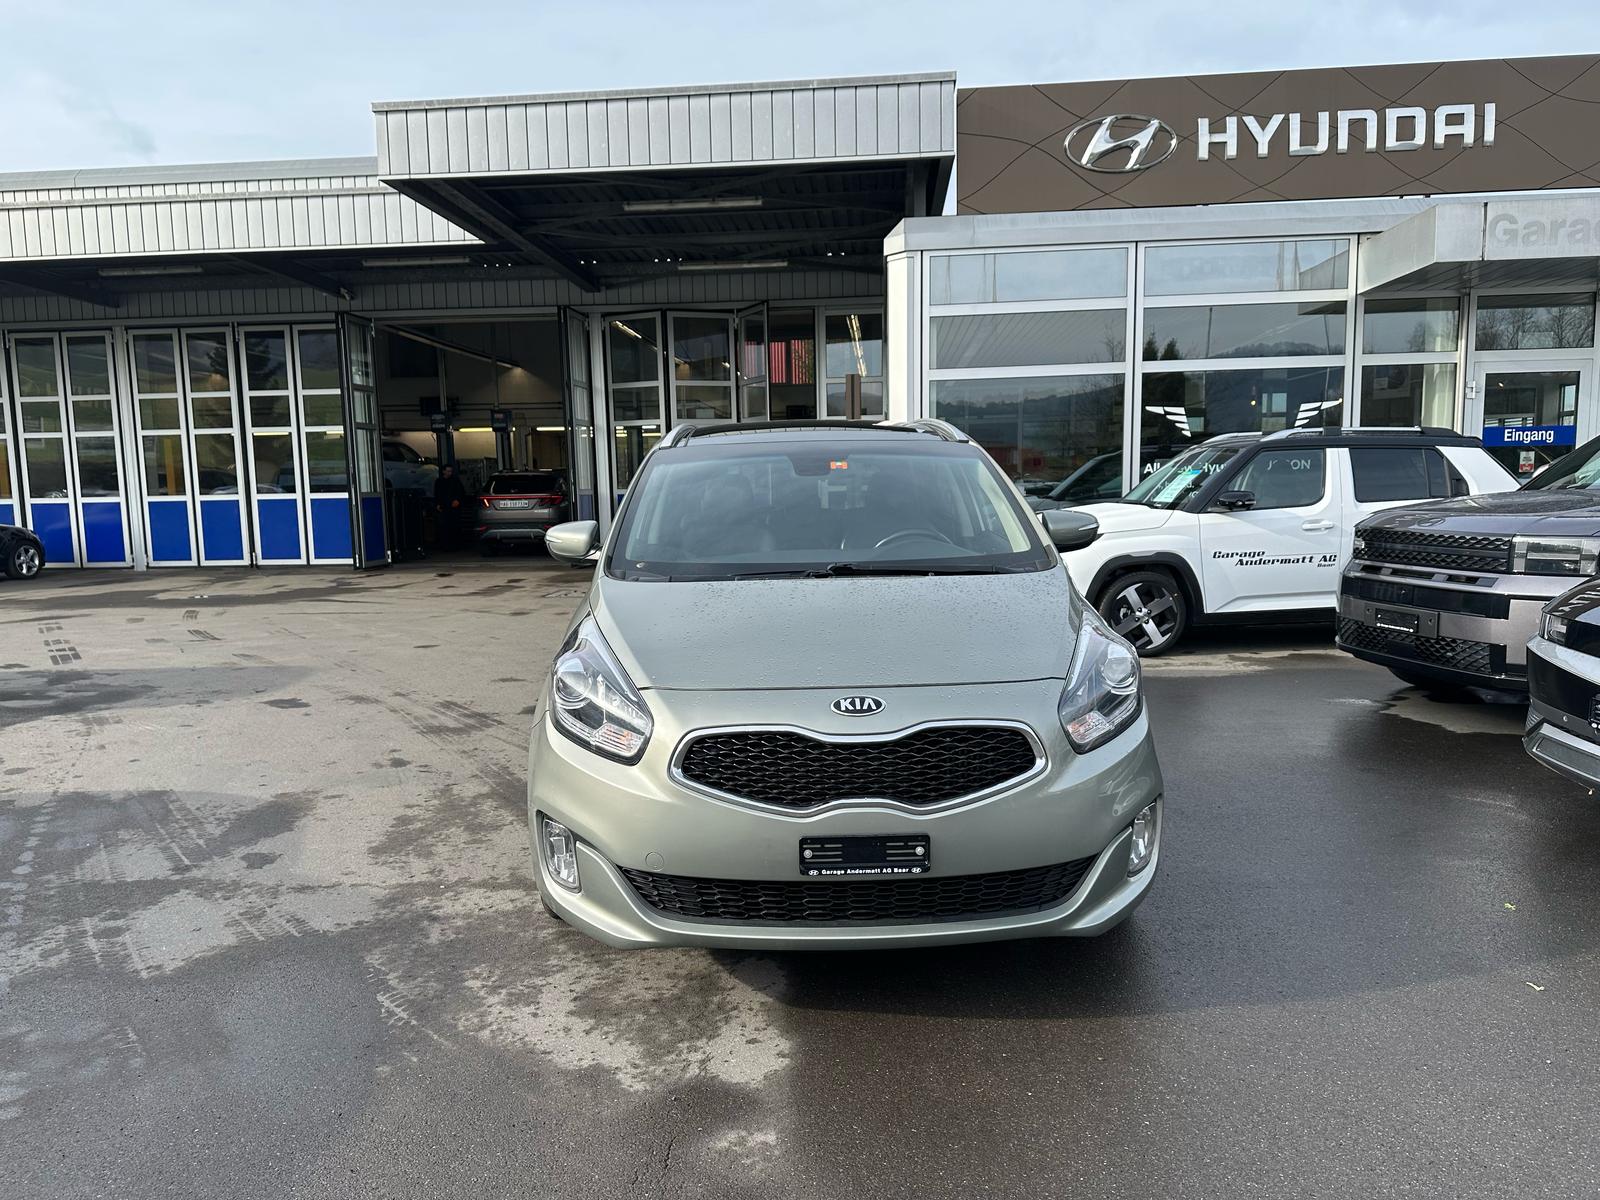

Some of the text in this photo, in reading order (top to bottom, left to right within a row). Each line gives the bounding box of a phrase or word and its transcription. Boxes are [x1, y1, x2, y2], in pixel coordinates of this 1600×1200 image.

[1197, 102, 1496, 161] HYUNDAI
[1489, 213, 1600, 248] Gara
[1504, 429, 1554, 443] Eingang
[1212, 551, 1266, 559] Garage
[1235, 554, 1337, 566] Andermatt AG
[839, 698, 877, 711] KIA
